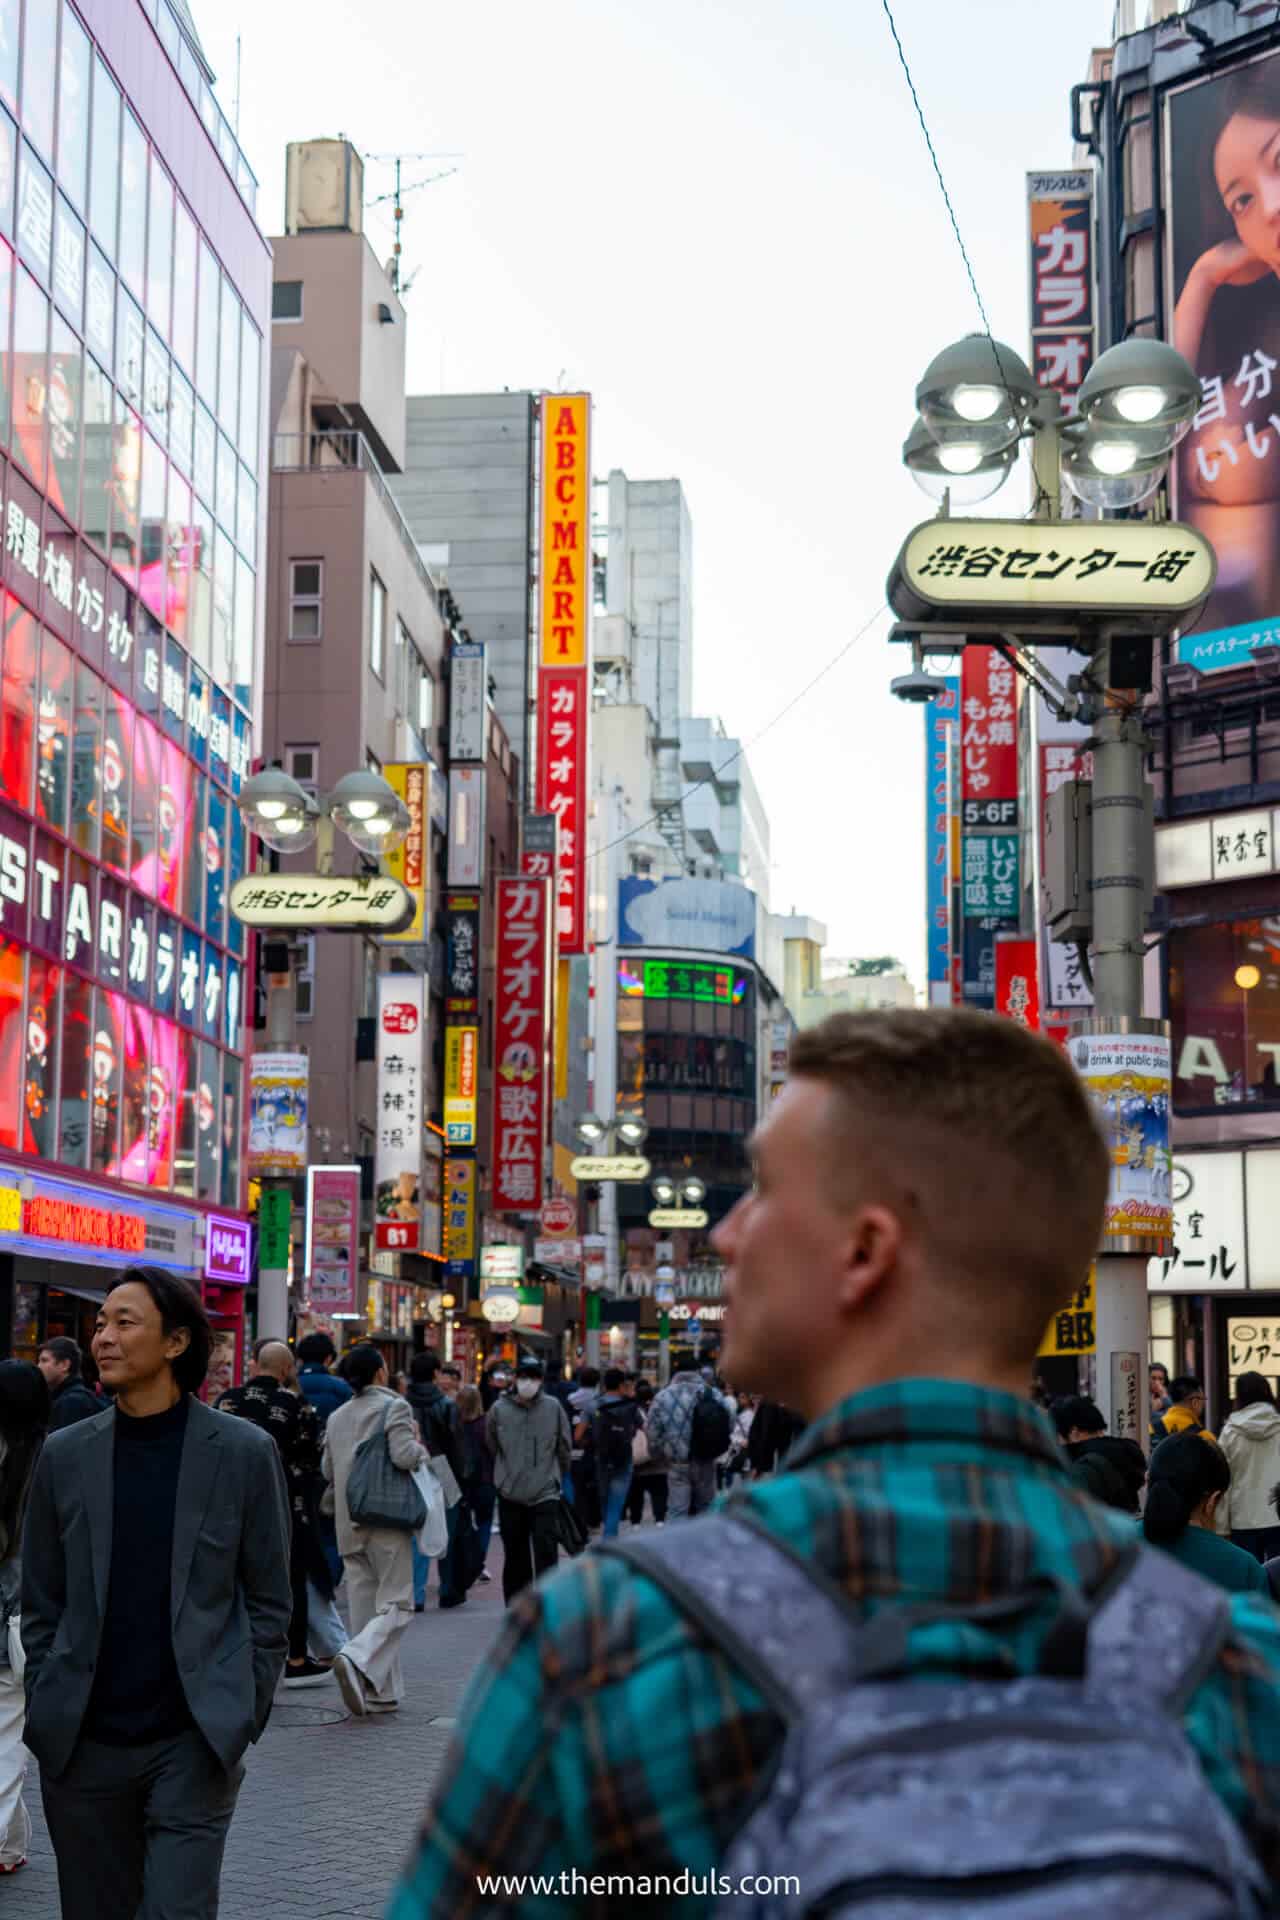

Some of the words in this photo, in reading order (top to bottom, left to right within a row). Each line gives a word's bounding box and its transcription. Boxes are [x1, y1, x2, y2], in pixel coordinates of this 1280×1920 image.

[1193, 349, 1277, 431] 自分
[918, 544, 1197, 583] 渋谷センター街
[964, 696, 990, 792] もんじゃ
[991, 837, 1016, 906] いびき
[238, 889, 398, 911] 渋谷センター街
[1114, 1054, 1123, 1064] at
[1125, 1054, 1151, 1069] public
